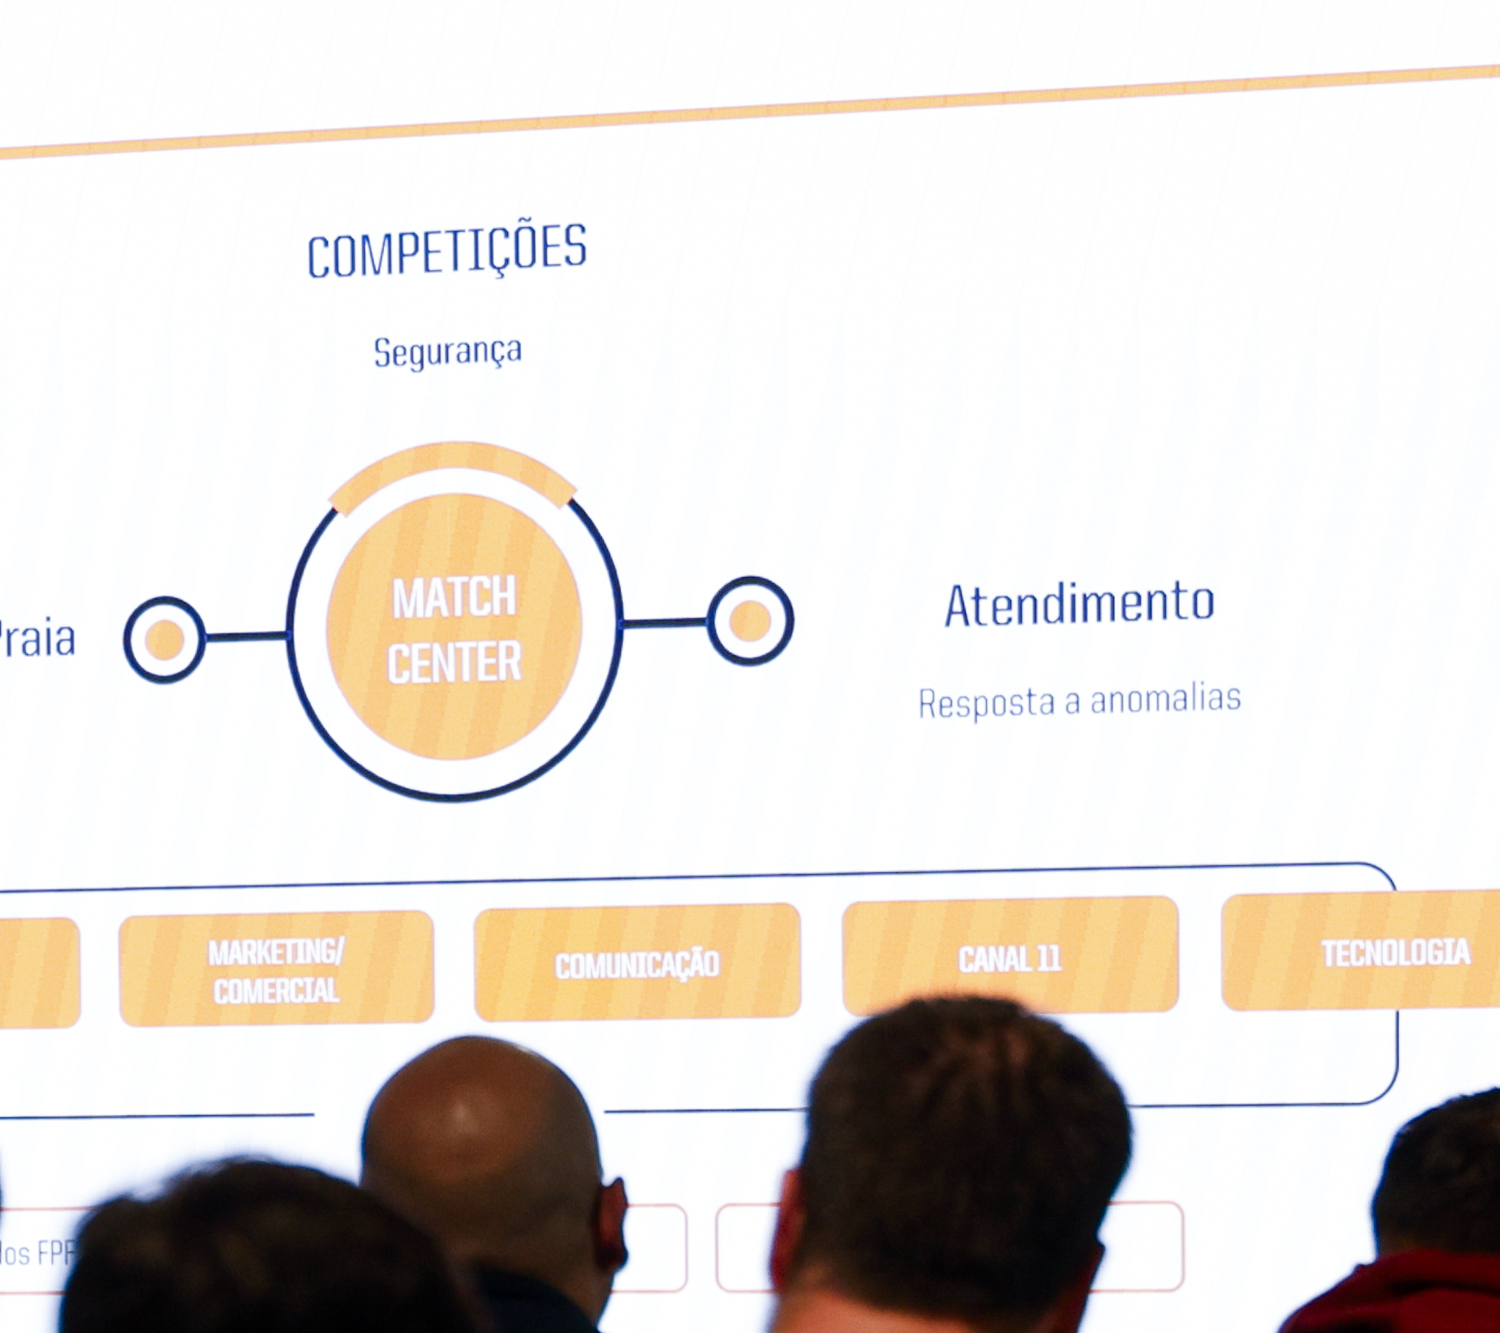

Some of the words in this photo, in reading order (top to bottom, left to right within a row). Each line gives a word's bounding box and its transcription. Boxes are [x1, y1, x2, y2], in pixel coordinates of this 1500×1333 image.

[308, 217, 587, 280] COMPETIÇÕES
[374, 337, 522, 374] Segurança
[392, 573, 517, 619] MATCH
[944, 579, 1215, 628] Atendimento
[387, 639, 523, 685] CENTER
[919, 685, 1055, 725] Resposta
[1065, 692, 1081, 715] a
[1091, 681, 1242, 714] anomalias
[208, 935, 346, 966] MARKETING/
[555, 946, 720, 983] COMUNICAÇÃO
[958, 945, 1032, 973] CANAL
[1037, 944, 1062, 972] 11
[1320, 937, 1473, 968] TECNOLOGIA
[214, 977, 341, 1004] COMERCIAL
